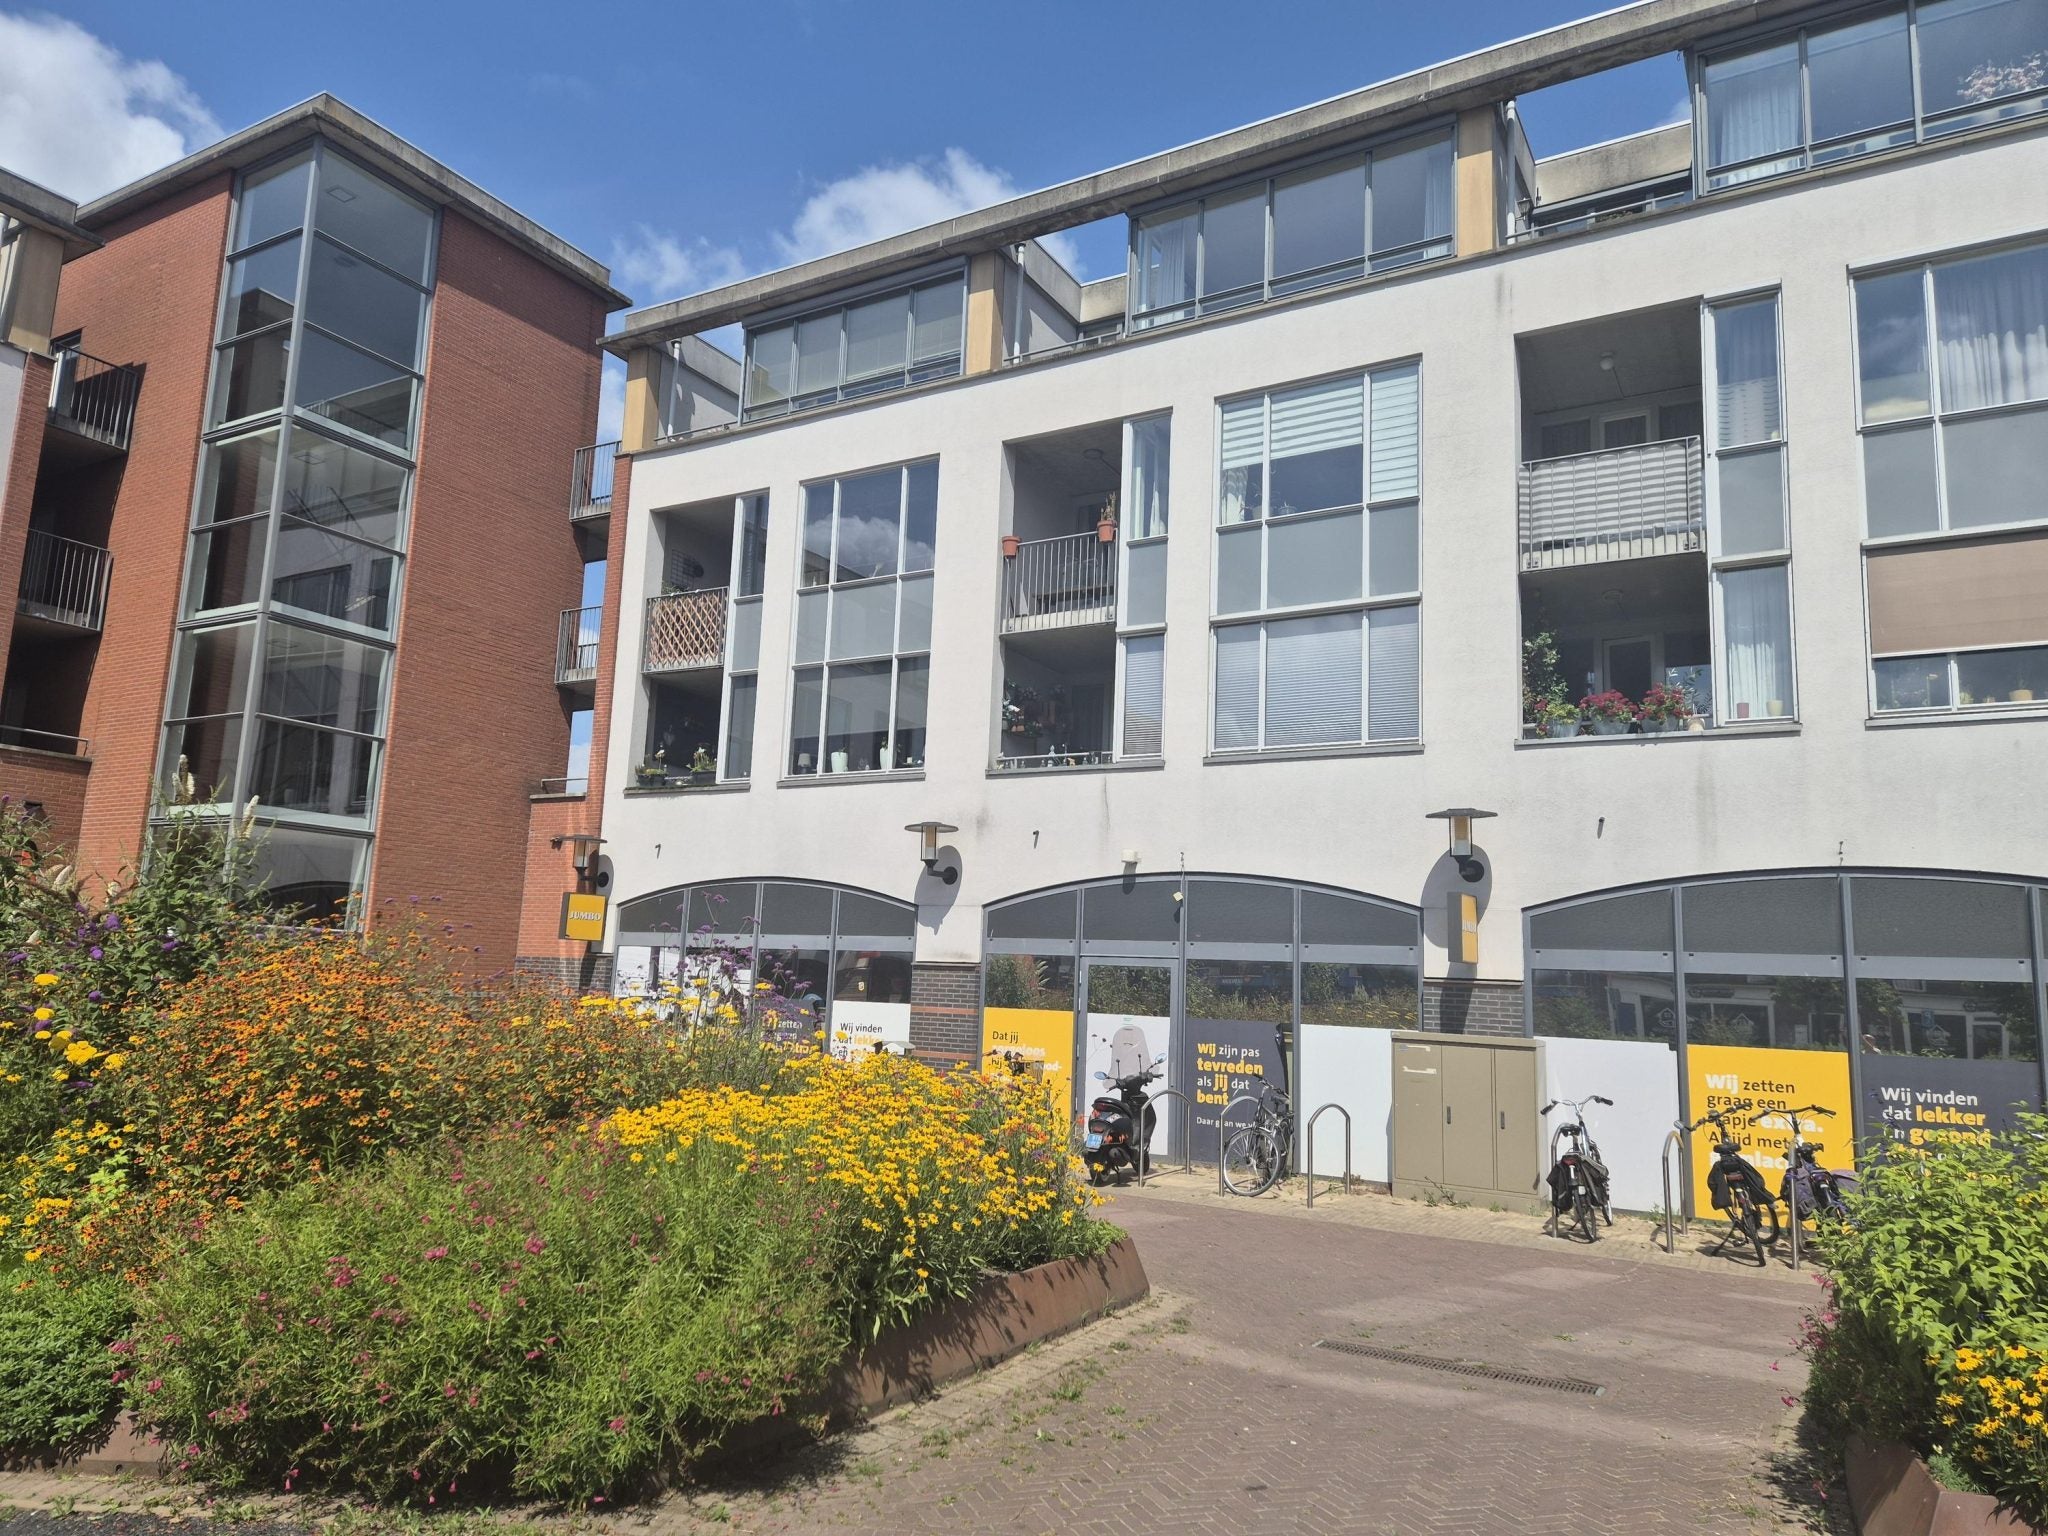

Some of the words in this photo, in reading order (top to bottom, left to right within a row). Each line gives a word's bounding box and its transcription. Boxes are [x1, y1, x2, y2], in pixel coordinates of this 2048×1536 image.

[569, 911, 602, 921] JUMBO
[840, 1023, 854, 1034] Wij
[855, 1024, 883, 1033] vinden
[992, 1031, 1009, 1041] Dat
[1010, 1032, 1019, 1044] jij
[1197, 1043, 1217, 1058] Wij
[1218, 1044, 1238, 1059] zijn
[1241, 1048, 1260, 1060] pas
[1196, 1057, 1264, 1076] tevreden
[1197, 1075, 1212, 1087] als
[1213, 1073, 1229, 1092] jij
[1231, 1077, 1250, 1090] dat
[1705, 1074, 1738, 1095] Wij
[1743, 1080, 1795, 1094] zetten
[1196, 1088, 1229, 1106] bent
[1707, 1095, 1753, 1111] graag
[1757, 1098, 1787, 1110] een
[1881, 1086, 1912, 1106] Wij
[1915, 1088, 1978, 1106] vinden
[1196, 1116, 1214, 1126] Daar
[1215, 1120, 1234, 1128] gan
[1710, 1112, 1757, 1130] apje
[1882, 1105, 1912, 1121] dat
[1915, 1104, 1986, 1126] lekker
[1708, 1131, 1752, 1147] Aijd
[1757, 1137, 1791, 1149] met
